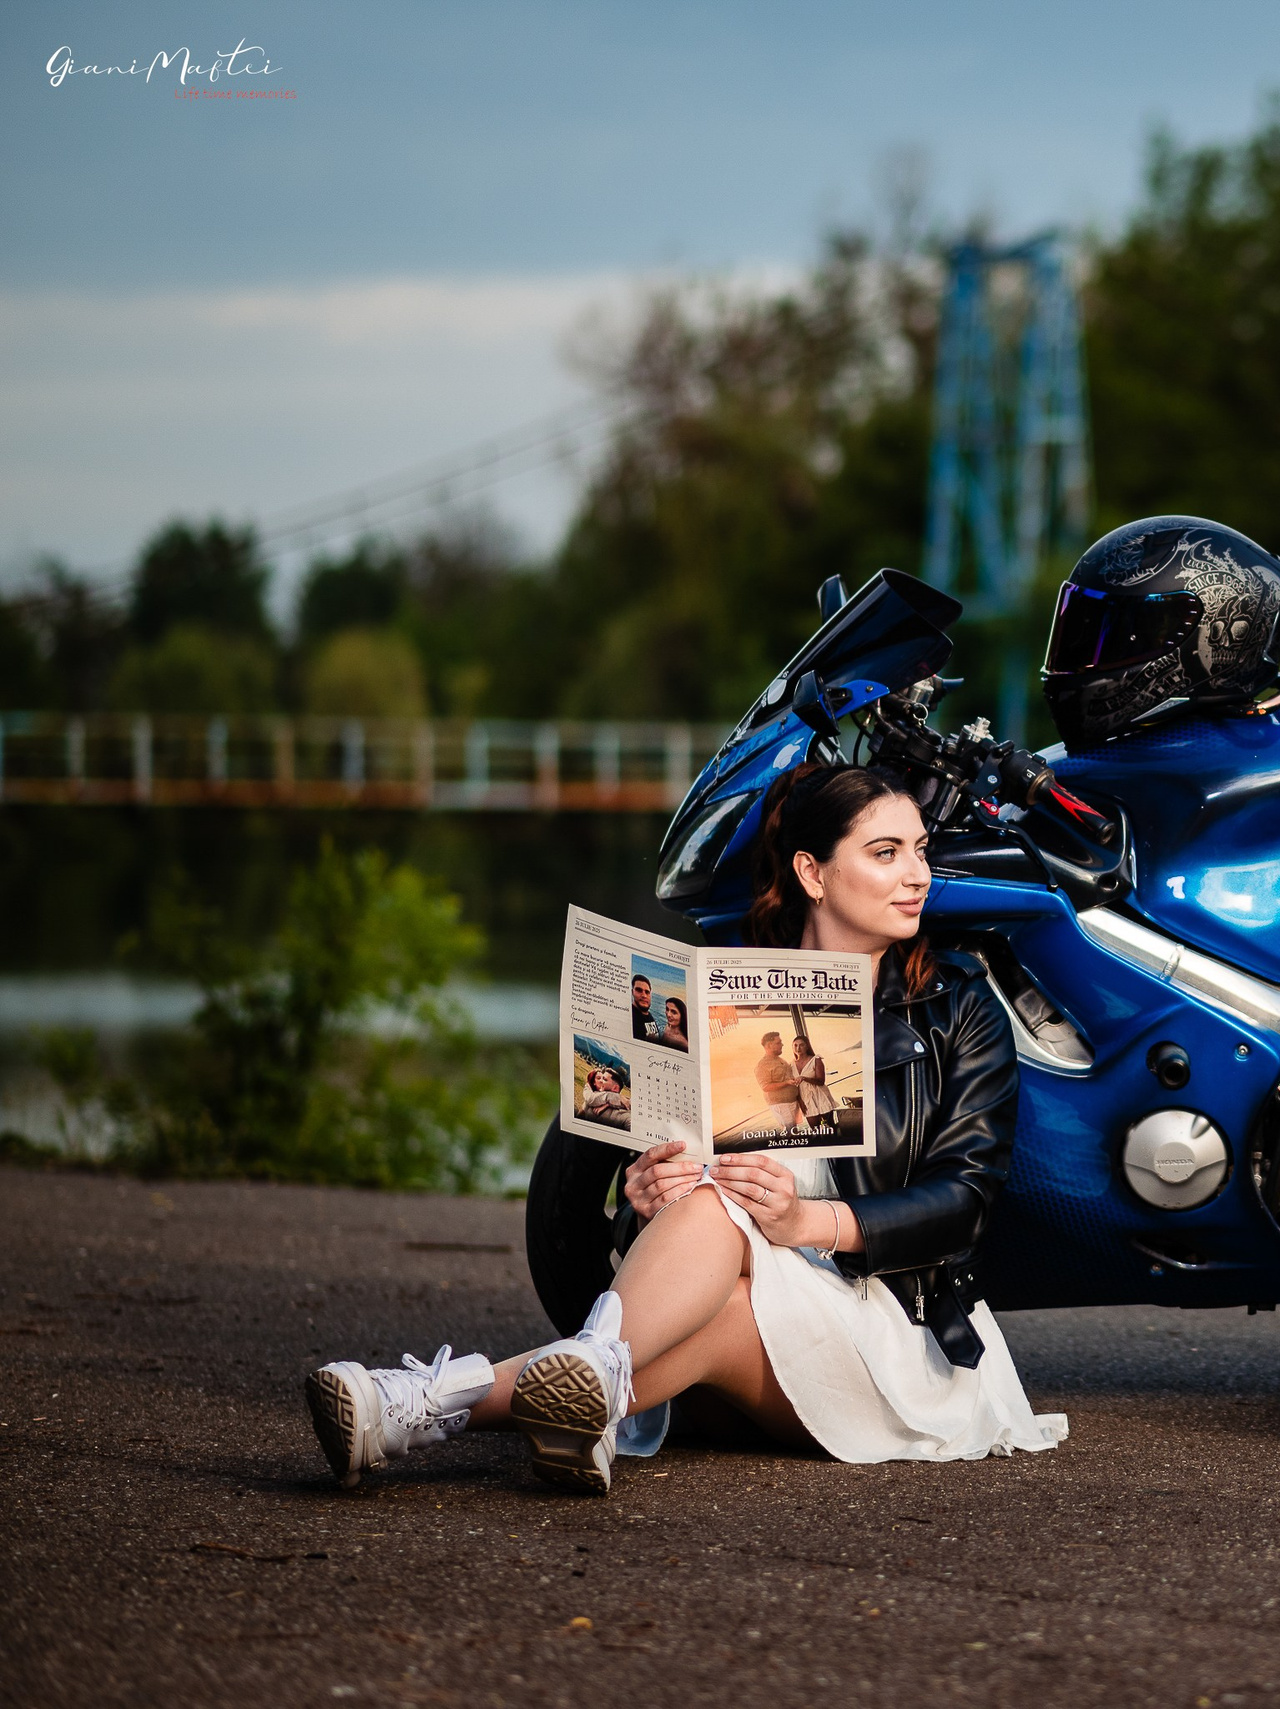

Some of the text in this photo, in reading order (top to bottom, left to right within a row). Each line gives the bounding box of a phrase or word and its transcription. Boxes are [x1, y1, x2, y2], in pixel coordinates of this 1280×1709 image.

[1186, 559, 1214, 572] LUCKY
[1188, 573, 1246, 593] SINCE 1968
[1144, 653, 1178, 679] GAIN
[708, 969, 859, 991] Save The Date
[742, 1128, 777, 1140] Ioana
[767, 1138, 809, 1147] 26.07.2025
